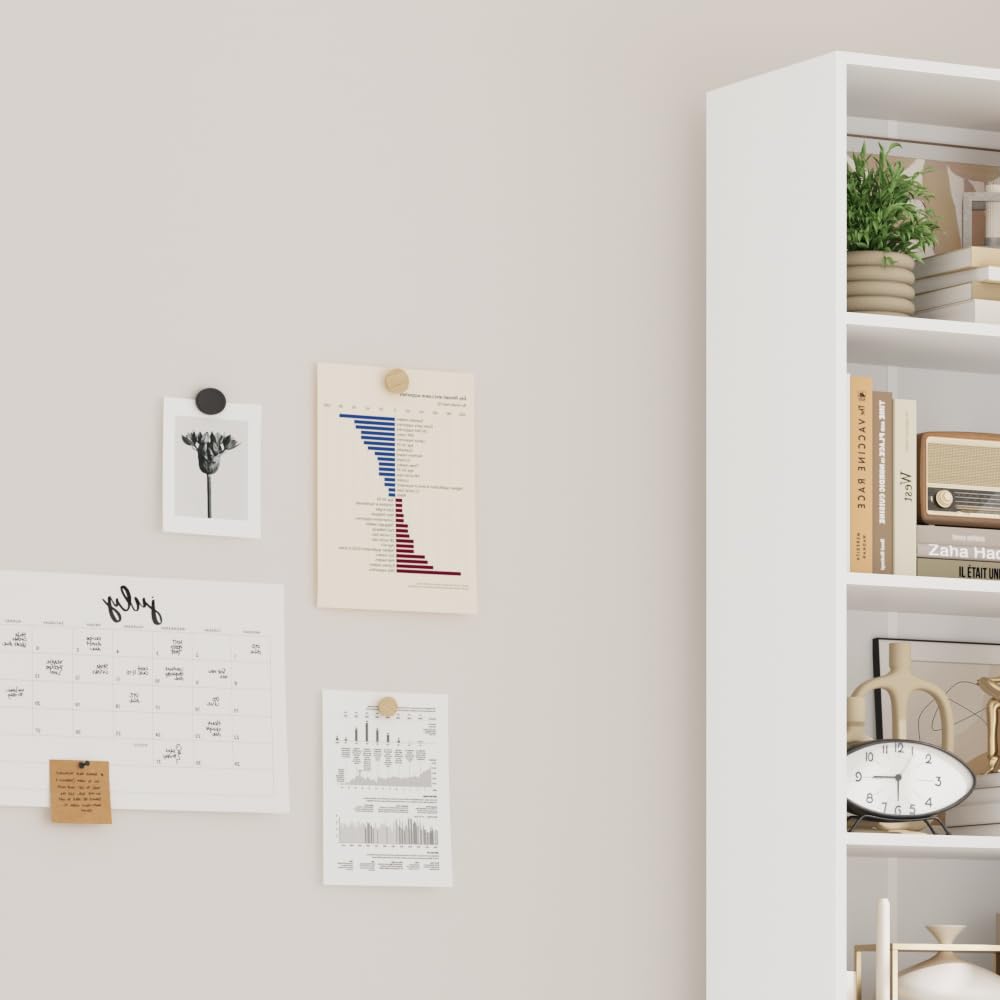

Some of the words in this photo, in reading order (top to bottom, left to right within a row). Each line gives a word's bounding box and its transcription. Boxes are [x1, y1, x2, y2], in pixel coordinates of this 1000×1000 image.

[928, 544, 968, 558] Zaha
[959, 566, 965, 578] IL
[968, 564, 987, 580] ÉTAIT
[882, 744, 888, 754] 11
[894, 742, 904, 753] 12
[865, 752, 874, 762] 10
[925, 754, 932, 764] 2
[855, 772, 862, 782] 9
[935, 776, 942, 786] 3
[866, 793, 874, 804] 8
[925, 797, 932, 808] 4
[881, 802, 887, 813] 7
[894, 804, 902, 815] 6
[909, 803, 916, 814] 5
